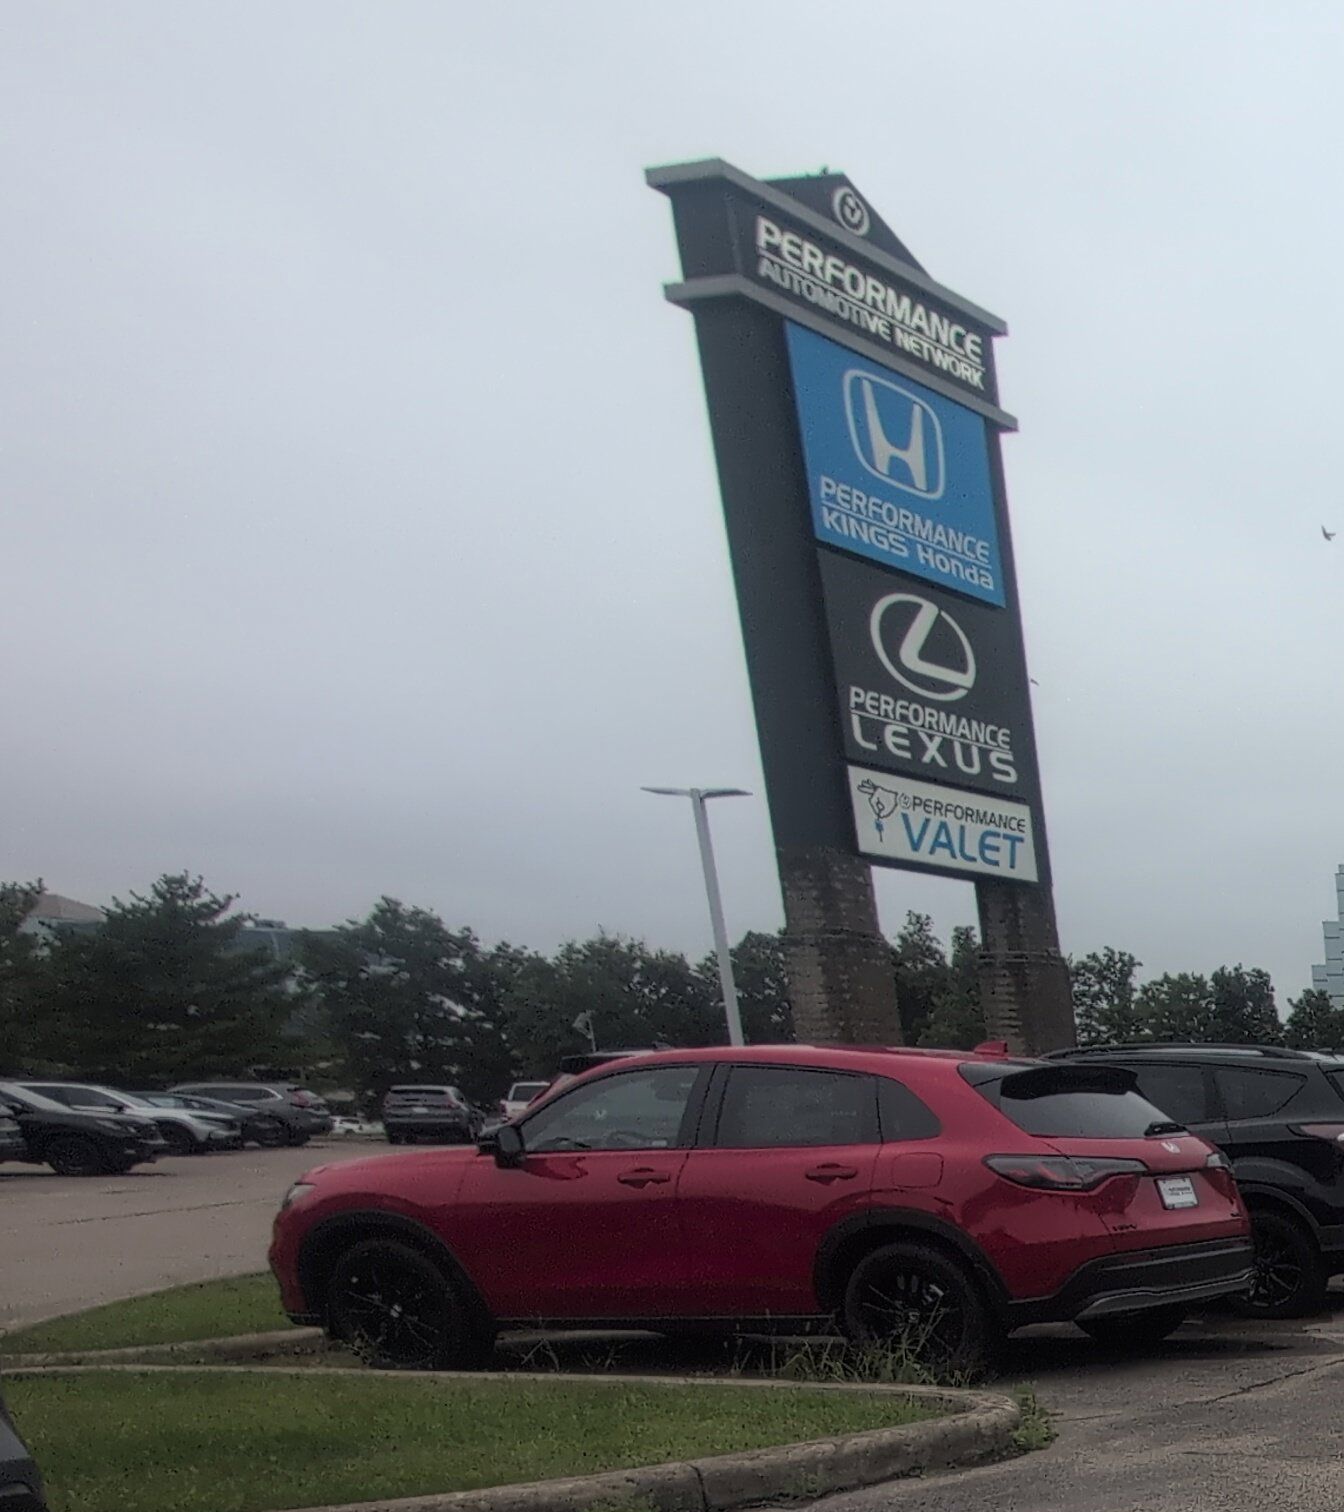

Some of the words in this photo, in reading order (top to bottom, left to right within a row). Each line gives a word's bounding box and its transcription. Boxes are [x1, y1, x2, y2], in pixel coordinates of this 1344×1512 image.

[757, 215, 983, 364] PERFORMANCE
[757, 256, 893, 342] AUTOMOTIVE
[893, 327, 985, 391] NETWORK
[820, 475, 990, 564] PERFORMANCE
[820, 505, 910, 558] KINGS
[916, 542, 995, 591] Honda
[850, 685, 1011, 751] PERFORMANCE
[850, 712, 1019, 784] LEXUS
[900, 812, 1025, 870] VALET
[911, 795, 1026, 834] PERFORMANCE
